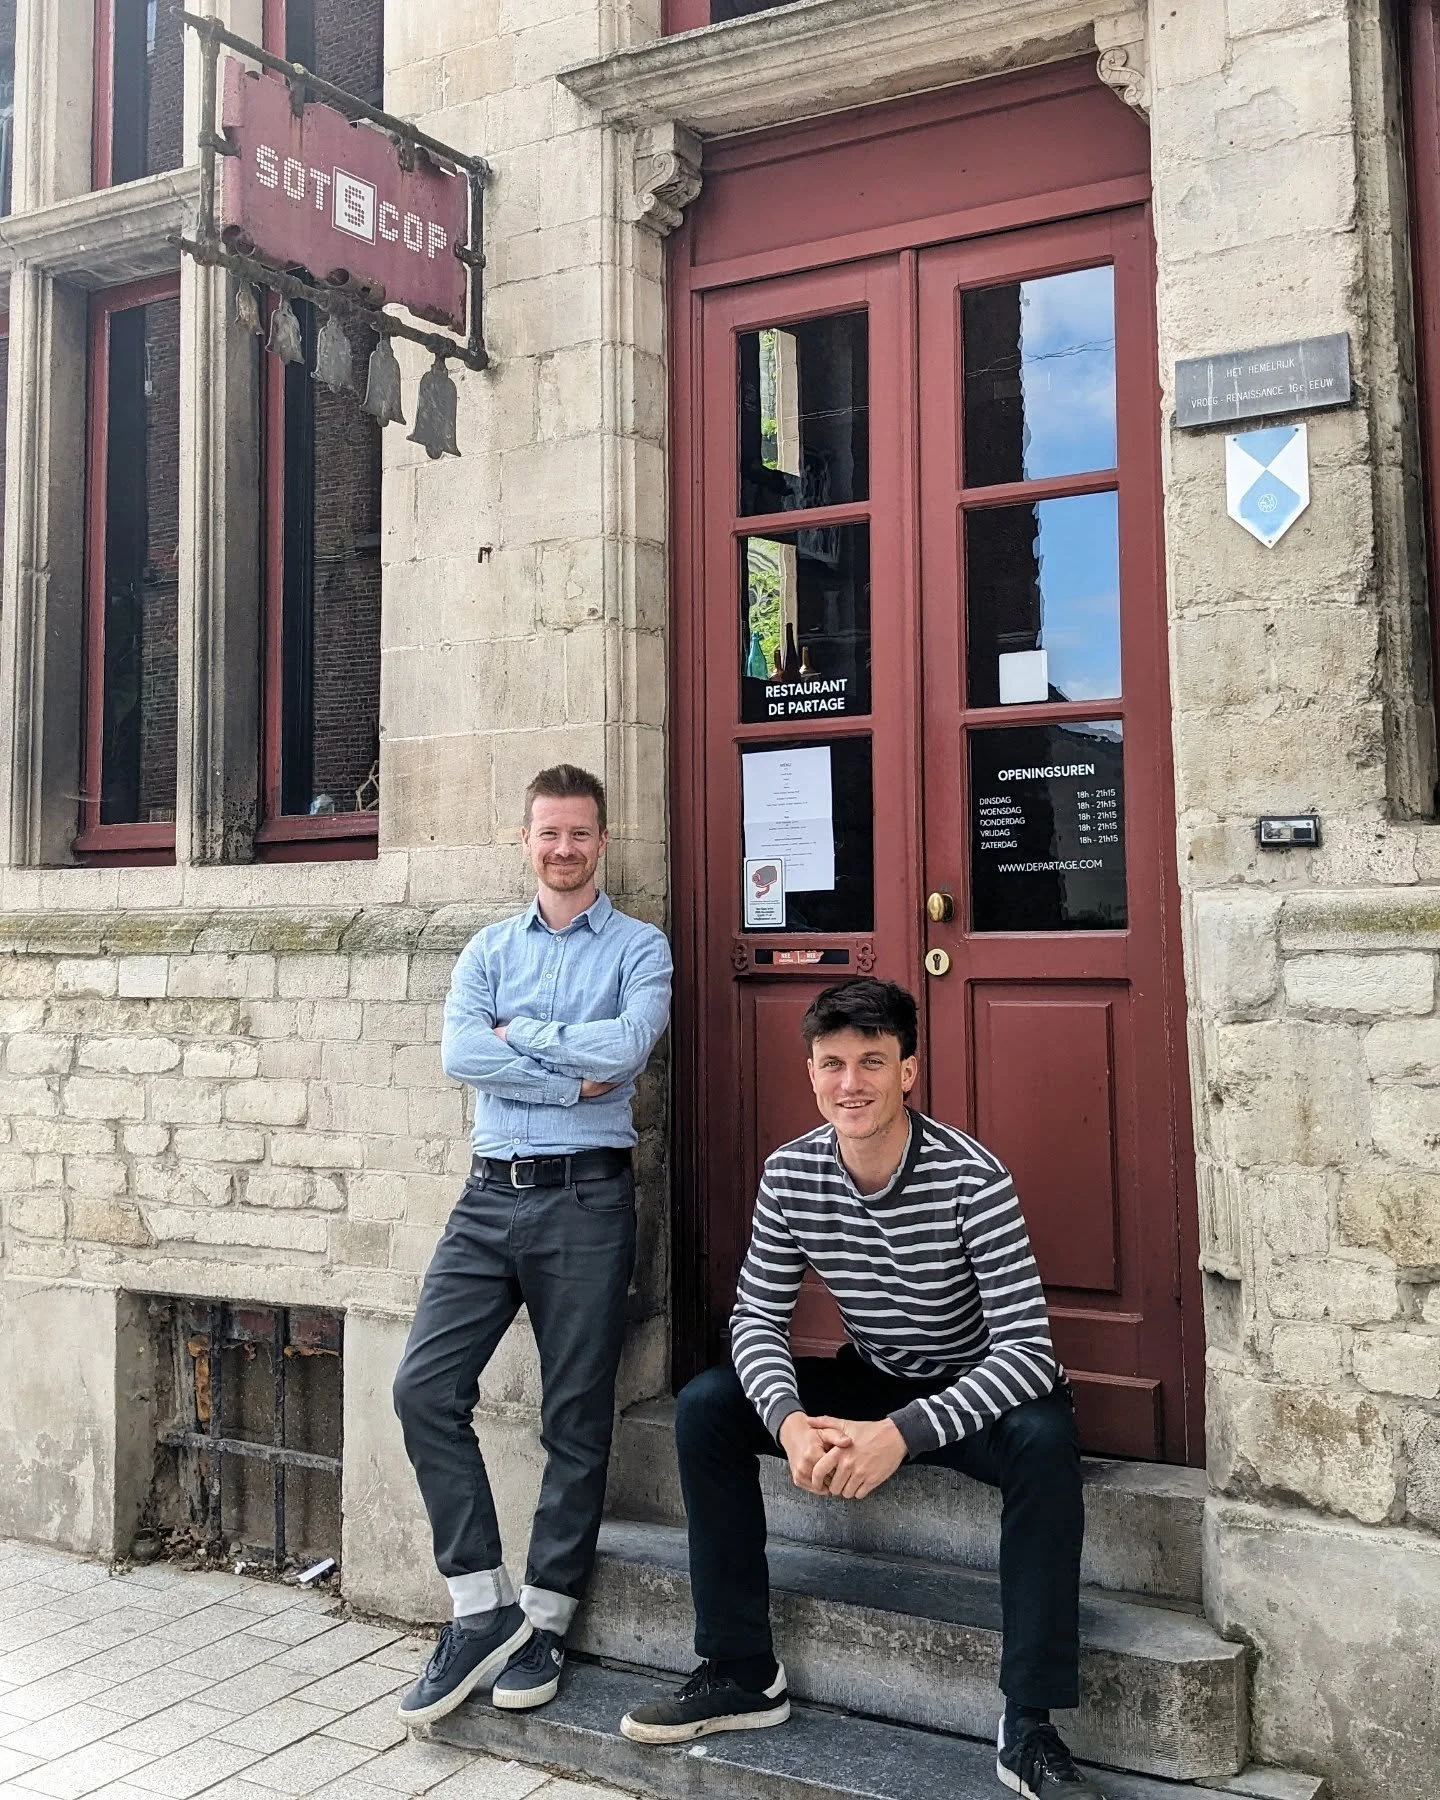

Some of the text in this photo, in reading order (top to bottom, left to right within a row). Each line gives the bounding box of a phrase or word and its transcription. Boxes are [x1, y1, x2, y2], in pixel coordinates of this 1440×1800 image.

[1226, 358, 1295, 378] HET HEMELRIJK
[1191, 396, 1219, 408] VROEG
[1226, 385, 1283, 403] RENAISSANCE
[1309, 378, 1334, 390] EEUW
[765, 679, 848, 698] RESTAURANT
[768, 697, 845, 716] DE PARTAGE
[997, 763, 1095, 781] OPENINGSUREN
[1077, 790, 1090, 798] 18h
[1095, 789, 1116, 798] 21h15
[979, 796, 1012, 806] DINSDAG
[1077, 801, 1090, 810] 18h
[1096, 800, 1117, 809] 21h15
[979, 806, 1022, 816] WOENSDAG
[1078, 812, 1091, 821] 18h
[1097, 811, 1117, 820] 21h15
[979, 817, 1026, 827] DONDERDAG
[1078, 823, 1091, 832] 18h
[1097, 822, 1118, 831] 21h15
[980, 828, 1011, 837] VRIJDAG
[1079, 836, 1092, 844] 18h
[1098, 834, 1119, 843] 21h15
[980, 840, 1018, 850] ZATERDAG
[997, 859, 1103, 873] WWW.DEPARTAGE.COM
